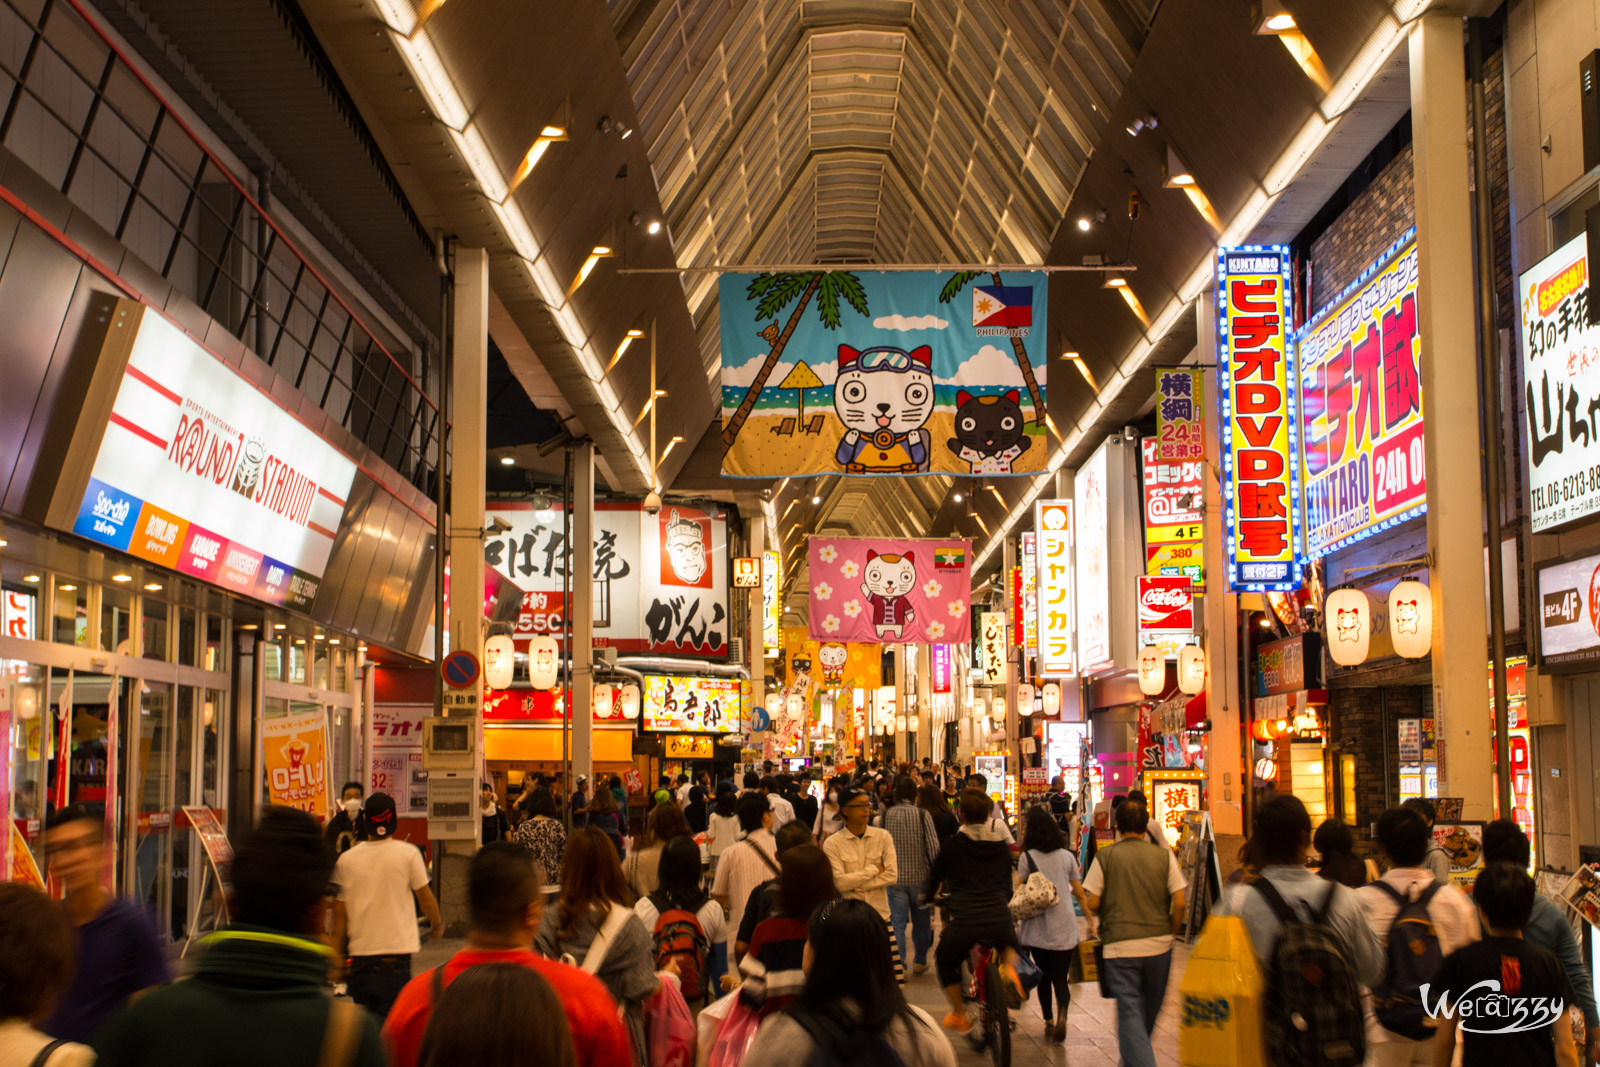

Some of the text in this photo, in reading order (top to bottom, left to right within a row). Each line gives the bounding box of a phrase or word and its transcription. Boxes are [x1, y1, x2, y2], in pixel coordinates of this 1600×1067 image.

[1228, 257, 1279, 269] KINTARO
[976, 327, 1030, 337] PHILIPPINES
[1160, 373, 1193, 422] 横綱
[1303, 288, 1422, 476] ビデオ試
[1231, 278, 1288, 557] ビデオDVD試写
[1144, 462, 1195, 485] コミック
[1160, 443, 1203, 459] 営業中
[1375, 434, 1426, 502] 24h O
[255, 454, 317, 527] STADIUM
[1306, 452, 1370, 532] KINTARO
[145, 514, 179, 545] BOWLING
[735, 574, 758, 586] がんこ
[1046, 535, 1067, 657] ジャンカラ
[645, 595, 726, 651] がんこ
[985, 626, 1002, 681] しもたや
[443, 694, 477, 706] 自動車
